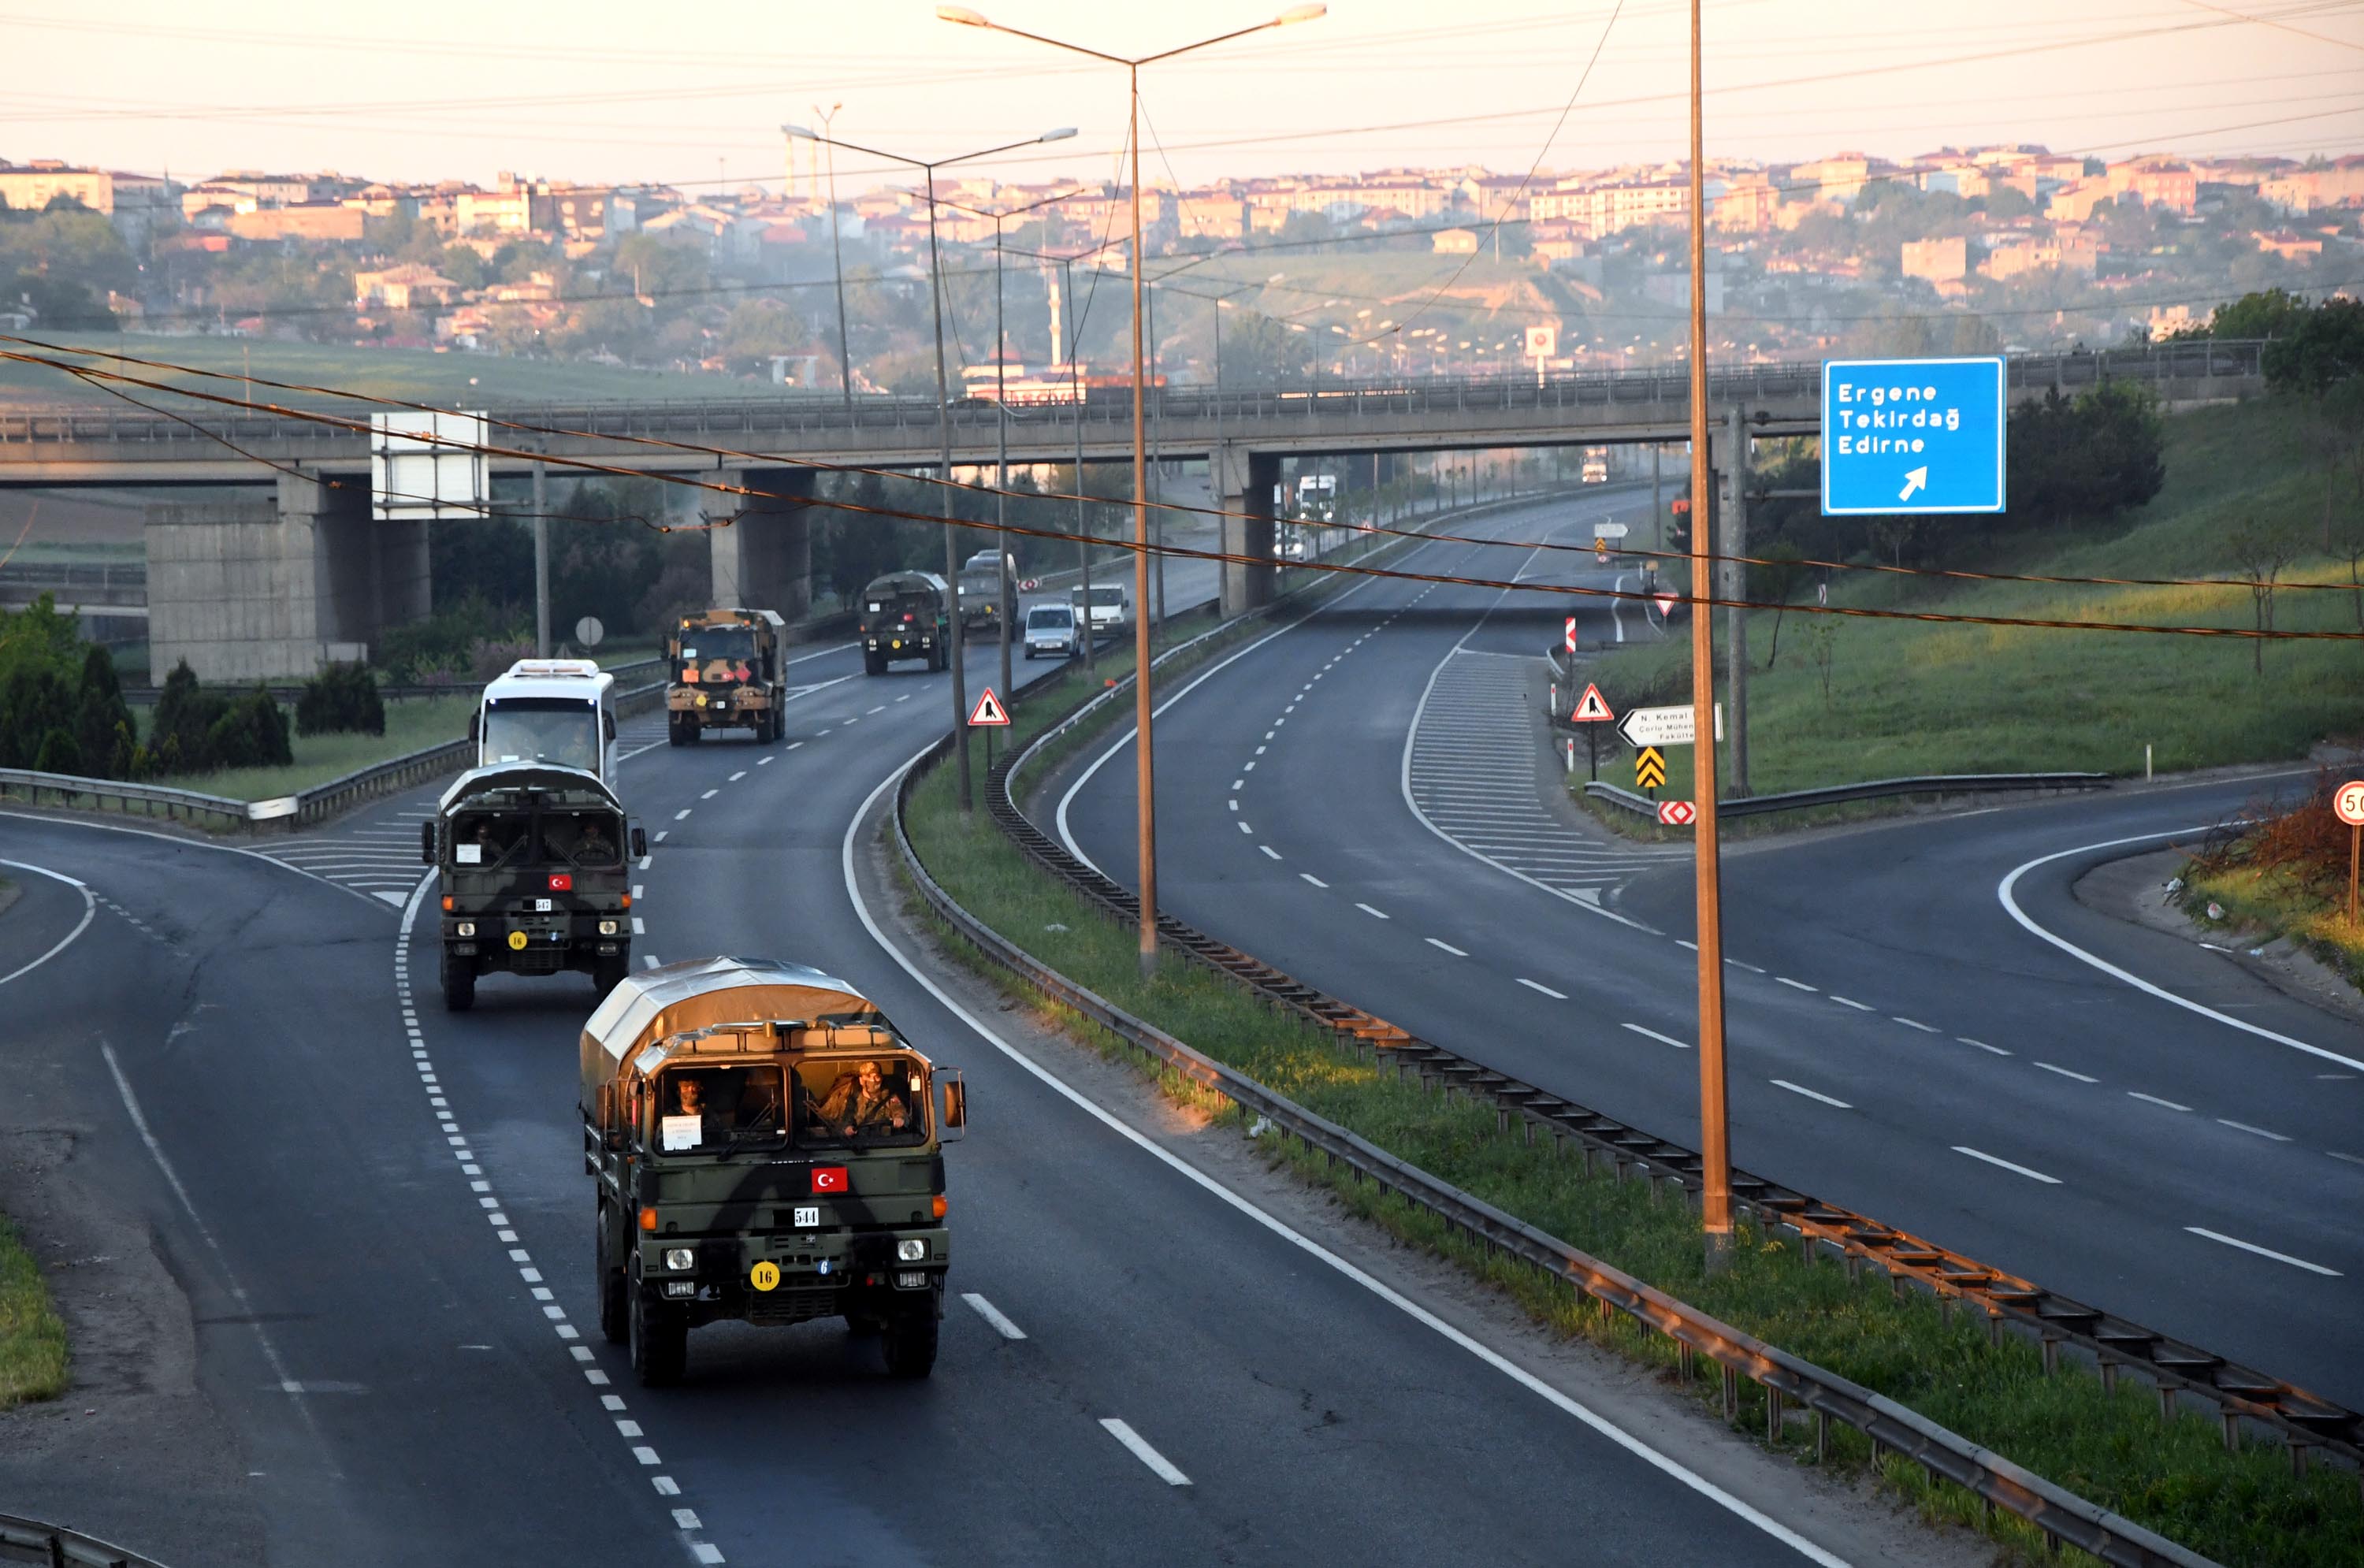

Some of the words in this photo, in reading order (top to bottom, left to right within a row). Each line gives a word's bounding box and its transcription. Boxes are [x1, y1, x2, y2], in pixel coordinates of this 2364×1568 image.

[1838, 384, 1937, 406] Ergene
[1839, 408, 1960, 431] Tekirdağ
[1838, 435, 1925, 455] Edirne
[1656, 712, 1688, 721] Kemal
[513, 937, 522, 946] 16
[796, 1210, 816, 1224] 544
[820, 1261, 828, 1274] 6
[759, 1270, 772, 1284] 16
